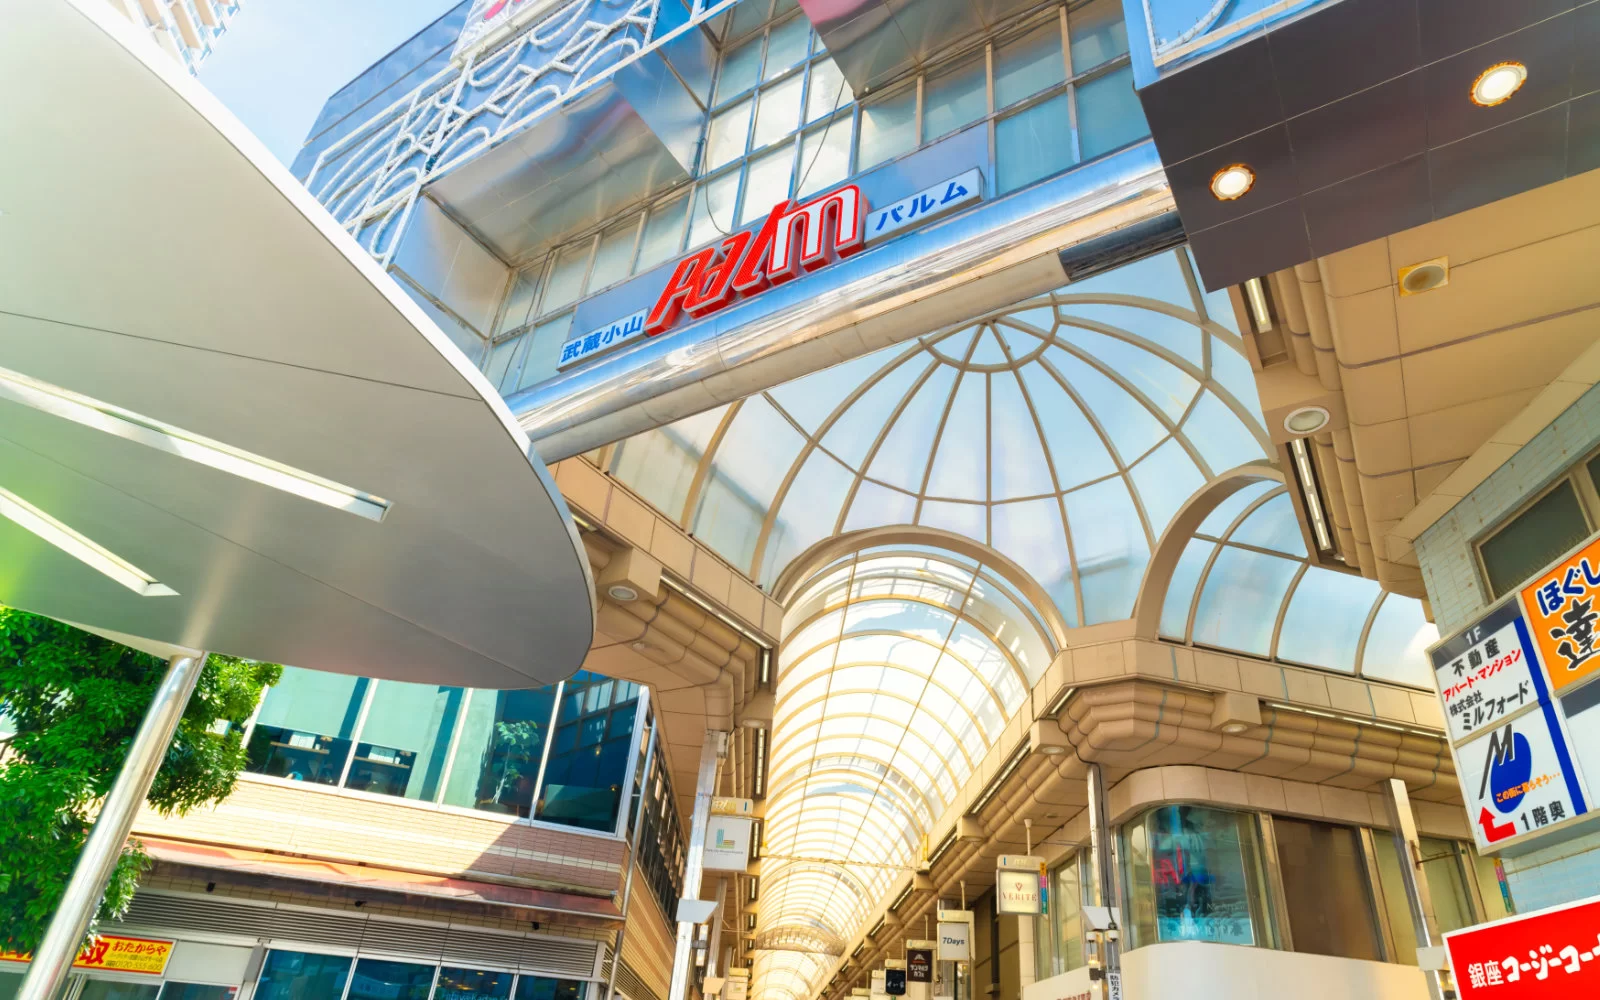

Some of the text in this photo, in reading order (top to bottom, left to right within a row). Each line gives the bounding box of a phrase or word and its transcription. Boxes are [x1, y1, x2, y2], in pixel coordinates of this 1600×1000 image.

[874, 181, 968, 231] パルム
[561, 313, 644, 363] 武蔵小山
[1466, 626, 1481, 646] 1F
[1443, 648, 1521, 702] アパート・マンション
[1451, 637, 1500, 677] 不動産
[1449, 690, 1484, 717] 株式会社
[1463, 680, 1529, 731] ミルフォード
[1520, 800, 1566, 831] 1階奥
[112, 941, 167, 956] おたからや
[942, 936, 965, 946] 7Days
[1467, 933, 1600, 989] 銀座コージーコー
